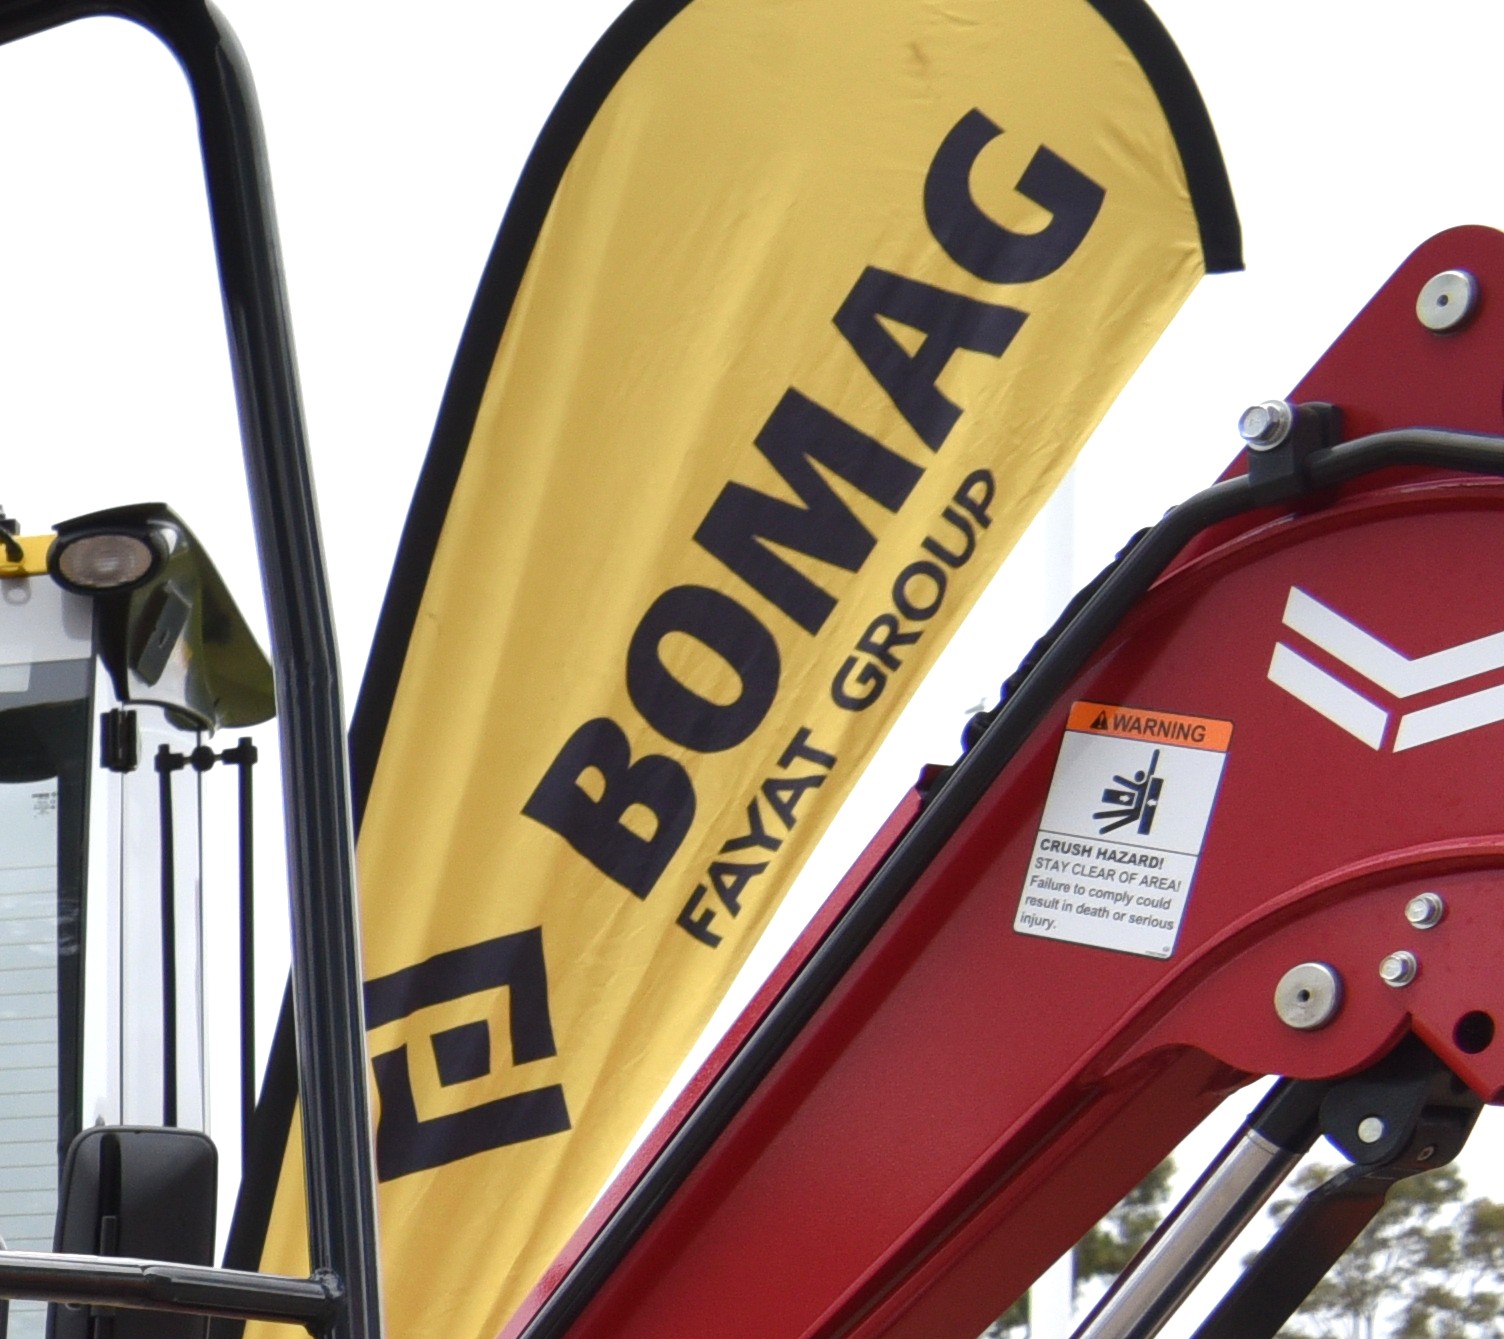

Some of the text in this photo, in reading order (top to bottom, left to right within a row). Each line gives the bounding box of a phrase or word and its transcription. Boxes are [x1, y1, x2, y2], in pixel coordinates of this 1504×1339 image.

[521, 106, 1107, 900] BOMAG
[677, 468, 998, 948] FAYAT GROUP
[1112, 713, 1206, 743] WARNING
[1040, 838, 1165, 870] CRUSH HAZARD!
[1035, 856, 1182, 892] STAY CLEAR OF AREA!
[1030, 875, 1171, 910] Failure to comply could
[1020, 912, 1056, 930] injury.
[1025, 893, 1175, 930] result in death or serious
